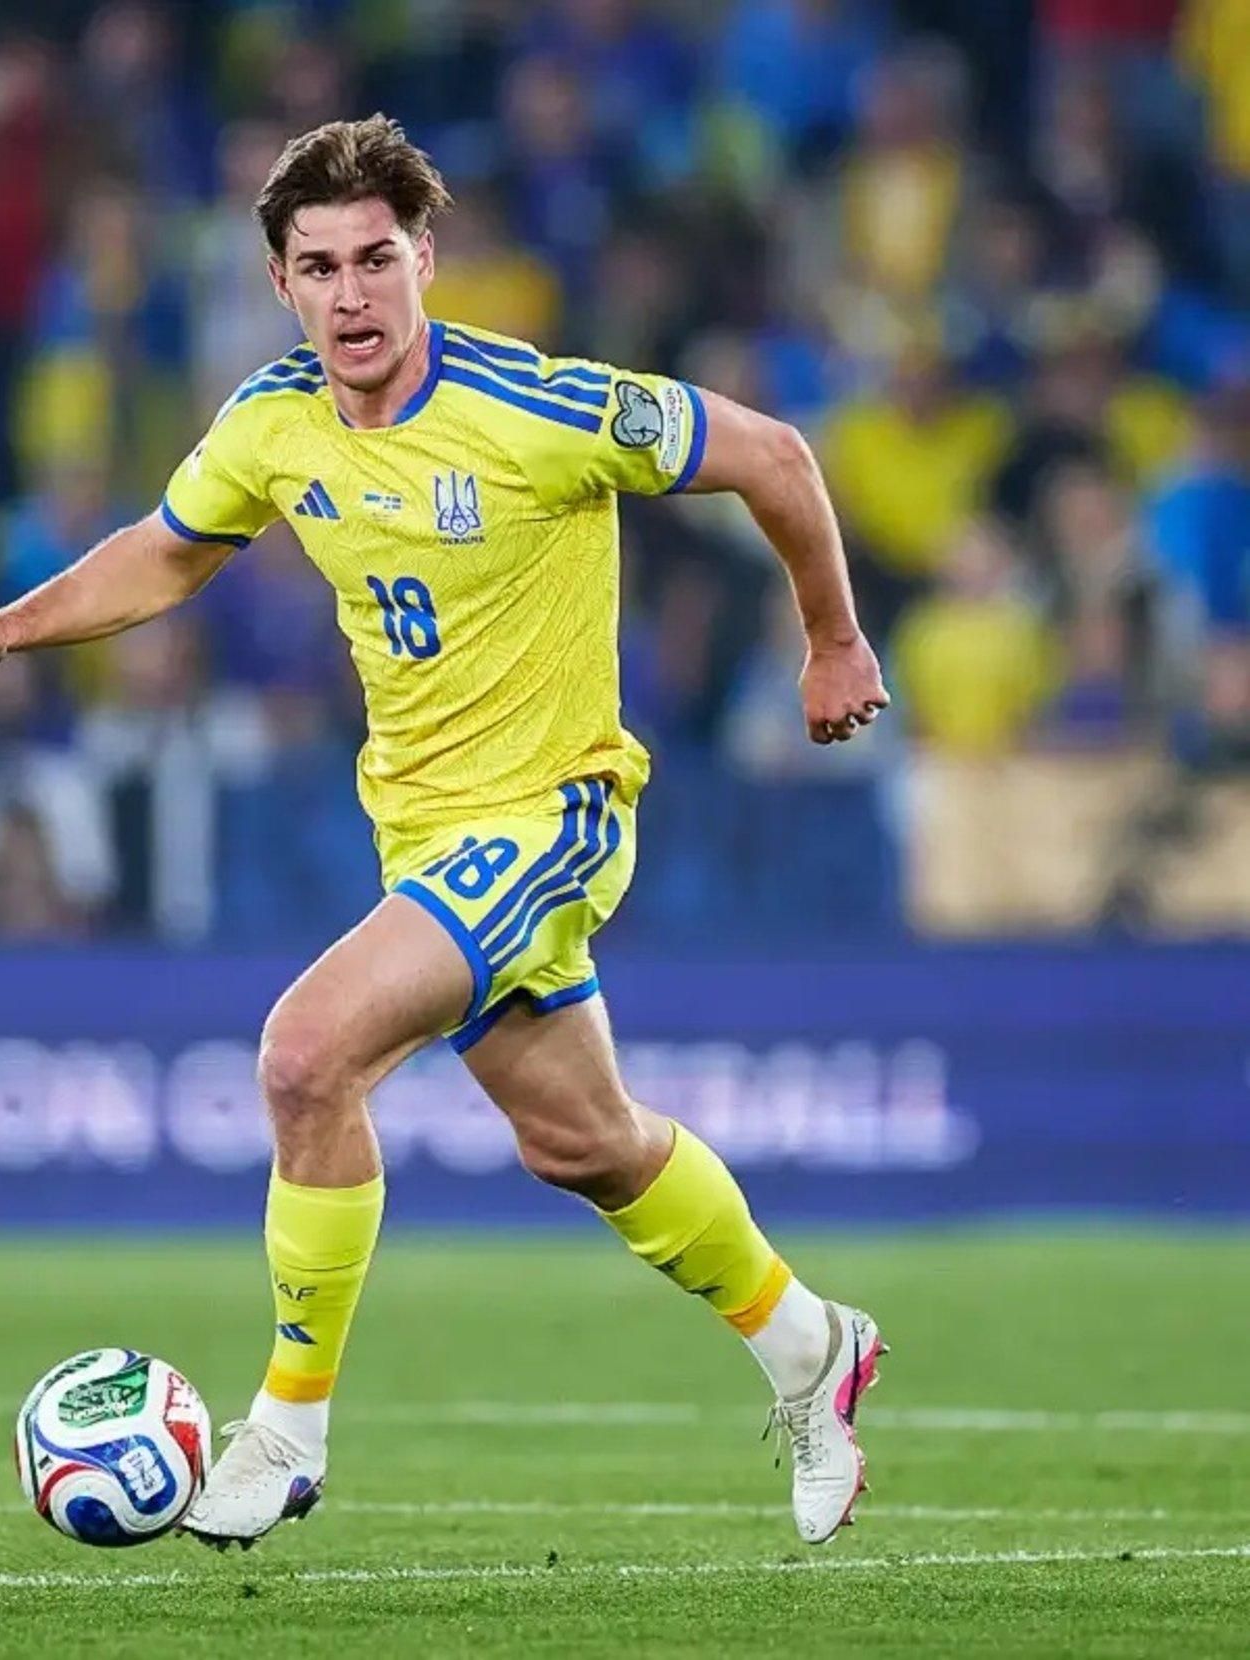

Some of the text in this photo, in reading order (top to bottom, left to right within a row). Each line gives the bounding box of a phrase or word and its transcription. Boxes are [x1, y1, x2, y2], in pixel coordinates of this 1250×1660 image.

[366, 575, 442, 660] 18
[422, 836, 519, 899] 18
[275, 1273, 318, 1300] AF
